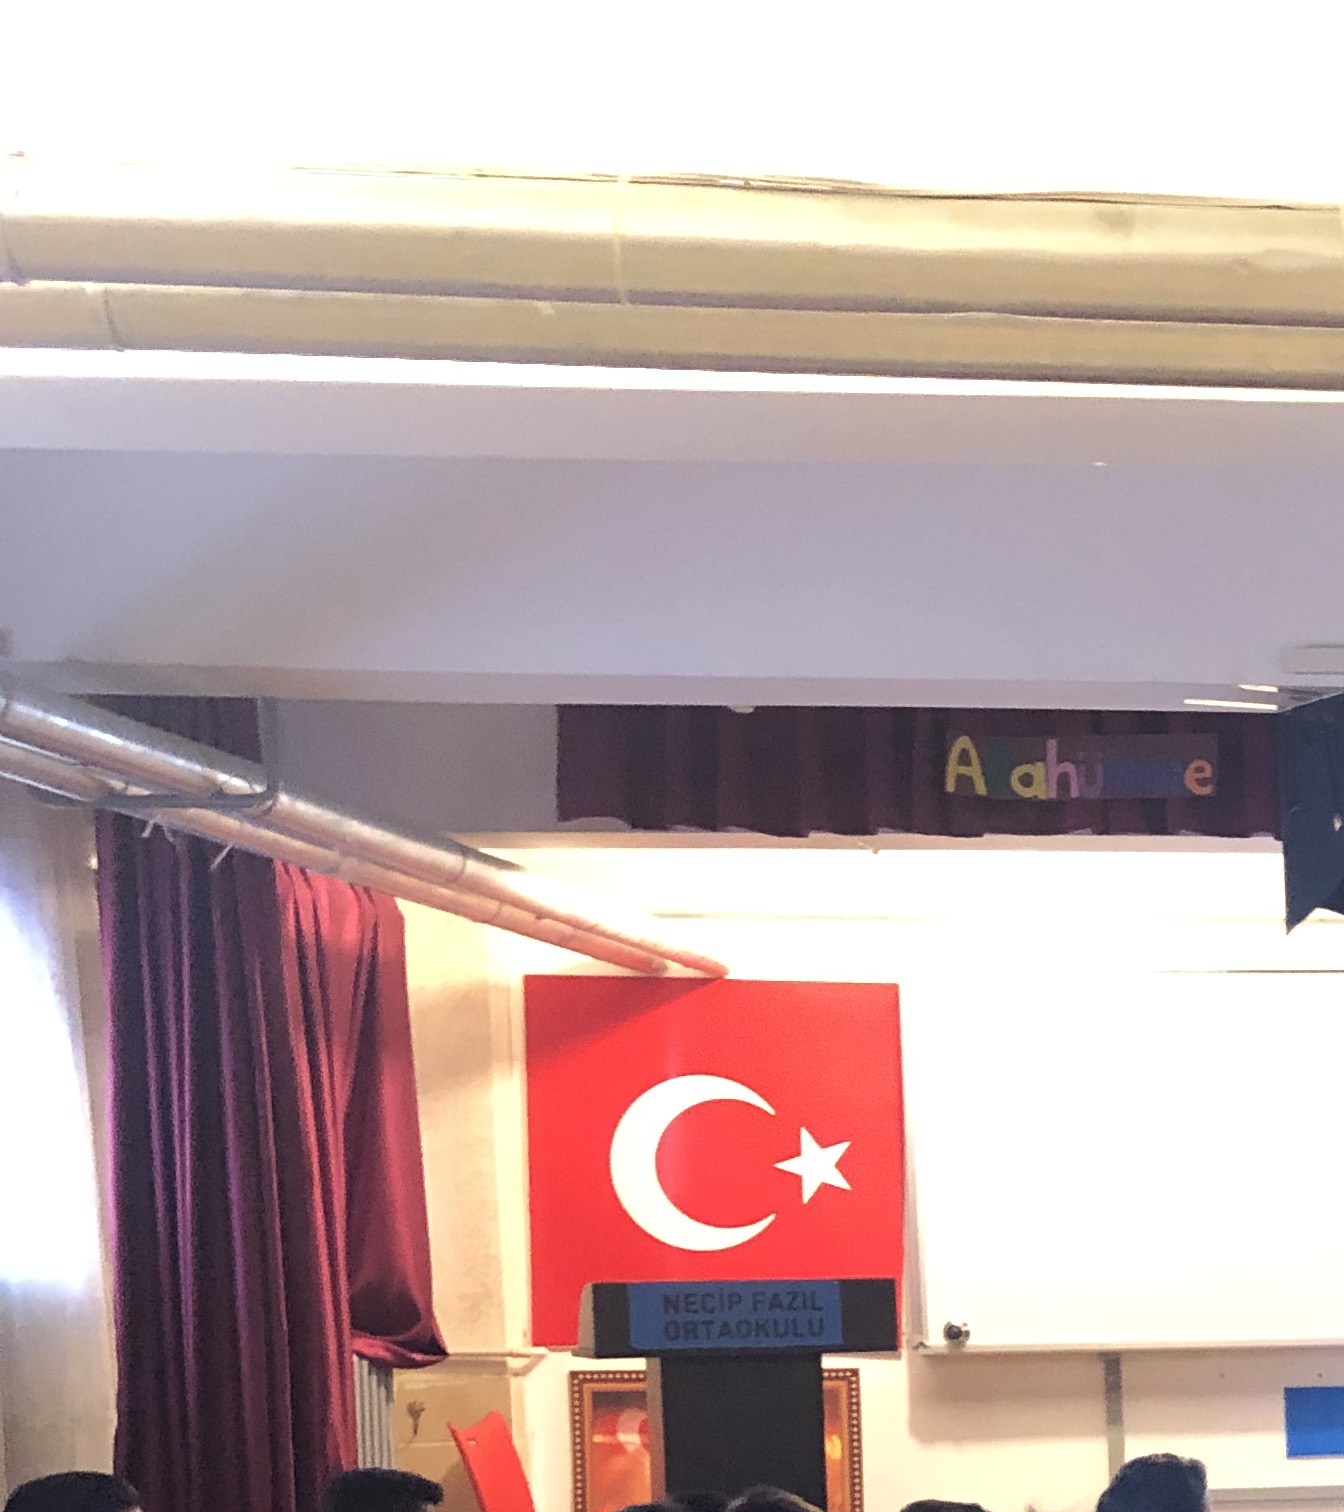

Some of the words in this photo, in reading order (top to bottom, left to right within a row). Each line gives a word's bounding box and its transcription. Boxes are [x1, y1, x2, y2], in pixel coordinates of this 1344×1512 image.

[663, 1288, 743, 1314] NECİP
[751, 1290, 825, 1312] FAZIL
[663, 1318, 824, 1342] ORTAOKULU
